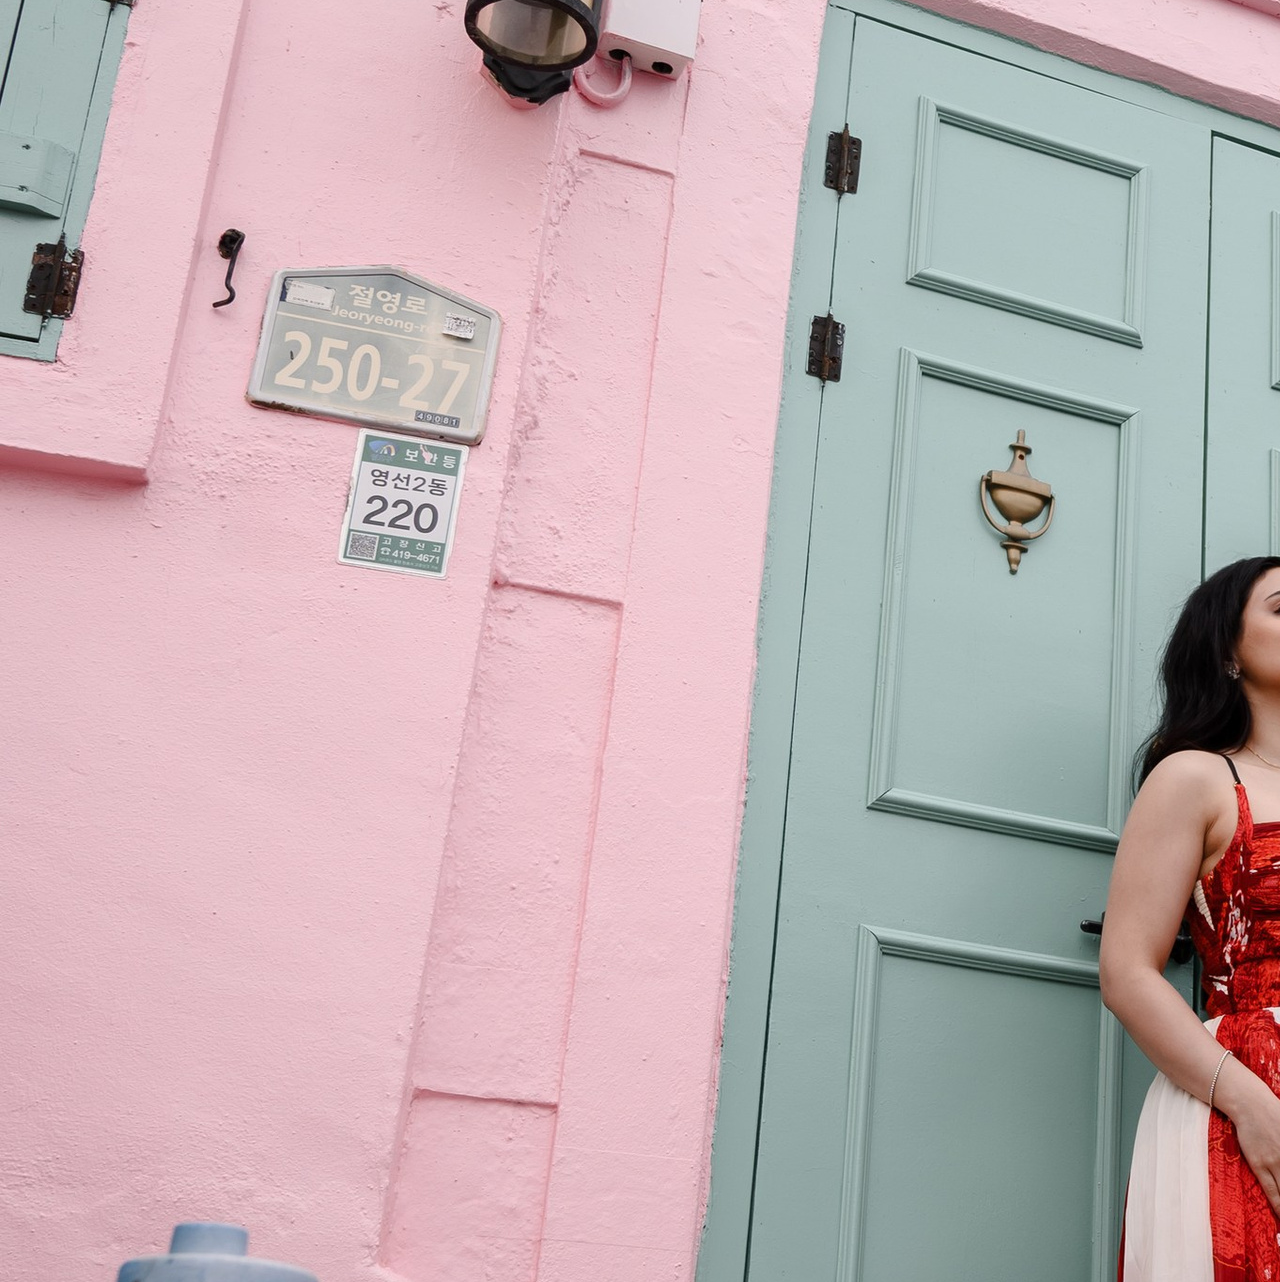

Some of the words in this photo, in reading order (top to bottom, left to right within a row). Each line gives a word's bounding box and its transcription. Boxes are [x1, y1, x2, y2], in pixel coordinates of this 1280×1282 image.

[348, 284, 427, 316] 절영로
[274, 330, 471, 415] 250-27
[417, 411, 459, 427] 49081
[370, 468, 448, 497] 영선2동
[362, 494, 439, 534] 220
[391, 549, 440, 564] 419-4671
